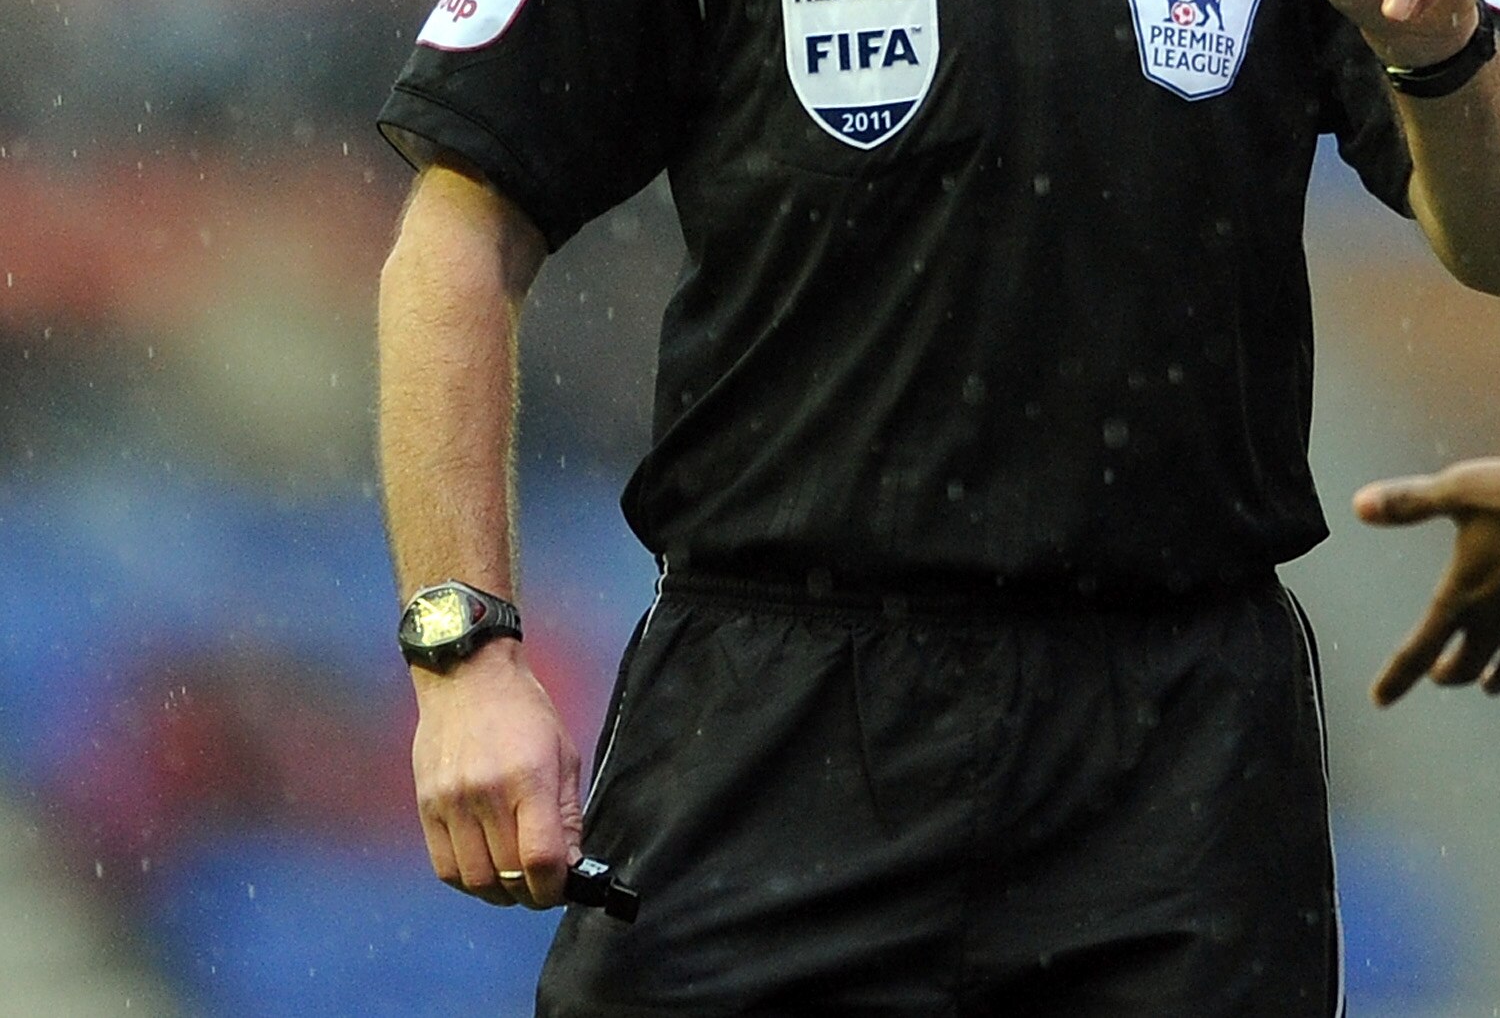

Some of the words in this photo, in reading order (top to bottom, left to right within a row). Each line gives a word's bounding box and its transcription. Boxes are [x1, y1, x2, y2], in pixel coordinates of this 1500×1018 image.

[1150, 25, 1236, 58] PREMIER
[1153, 47, 1231, 78] LEAGUE
[841, 109, 892, 133] 2011
